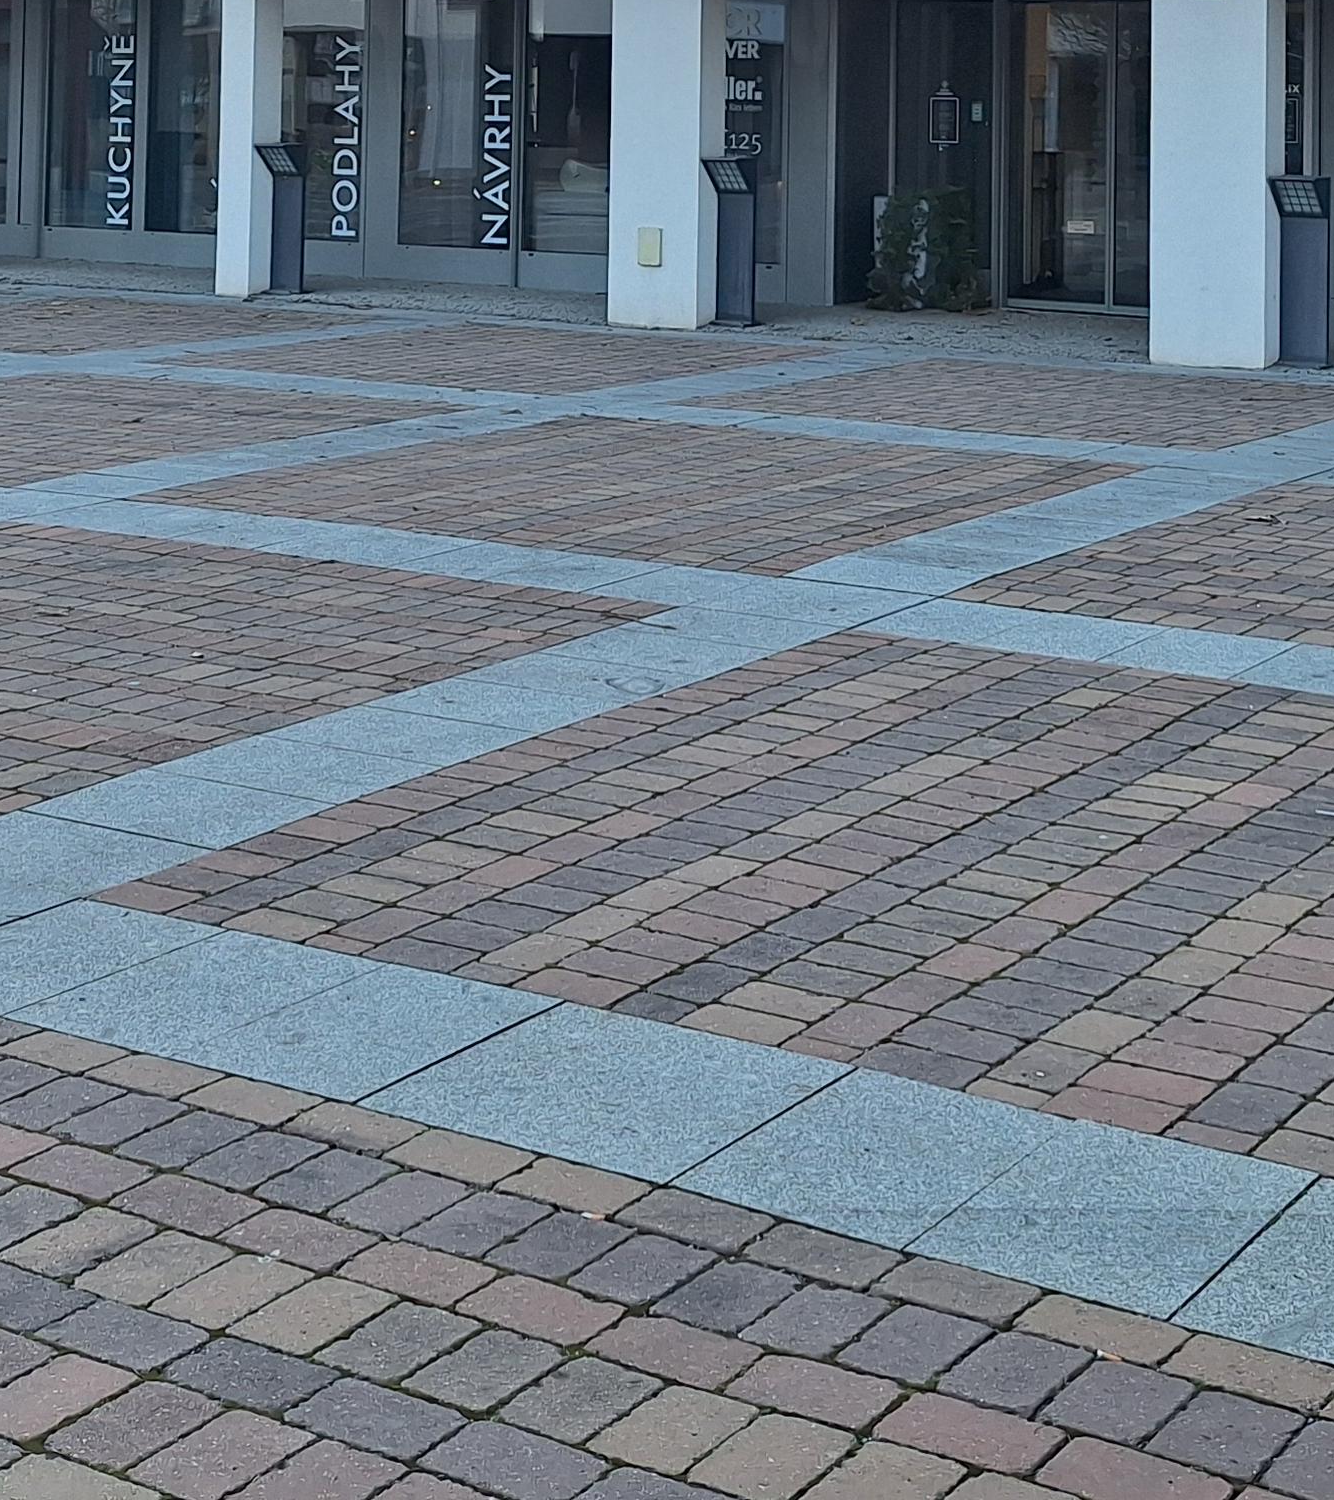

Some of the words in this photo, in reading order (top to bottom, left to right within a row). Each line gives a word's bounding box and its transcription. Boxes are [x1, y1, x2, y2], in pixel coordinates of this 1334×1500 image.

[103, 35, 135, 226] KUCHYNĚ
[331, 35, 362, 237] PODLAHY
[473, 63, 512, 245] NÁVRHY
